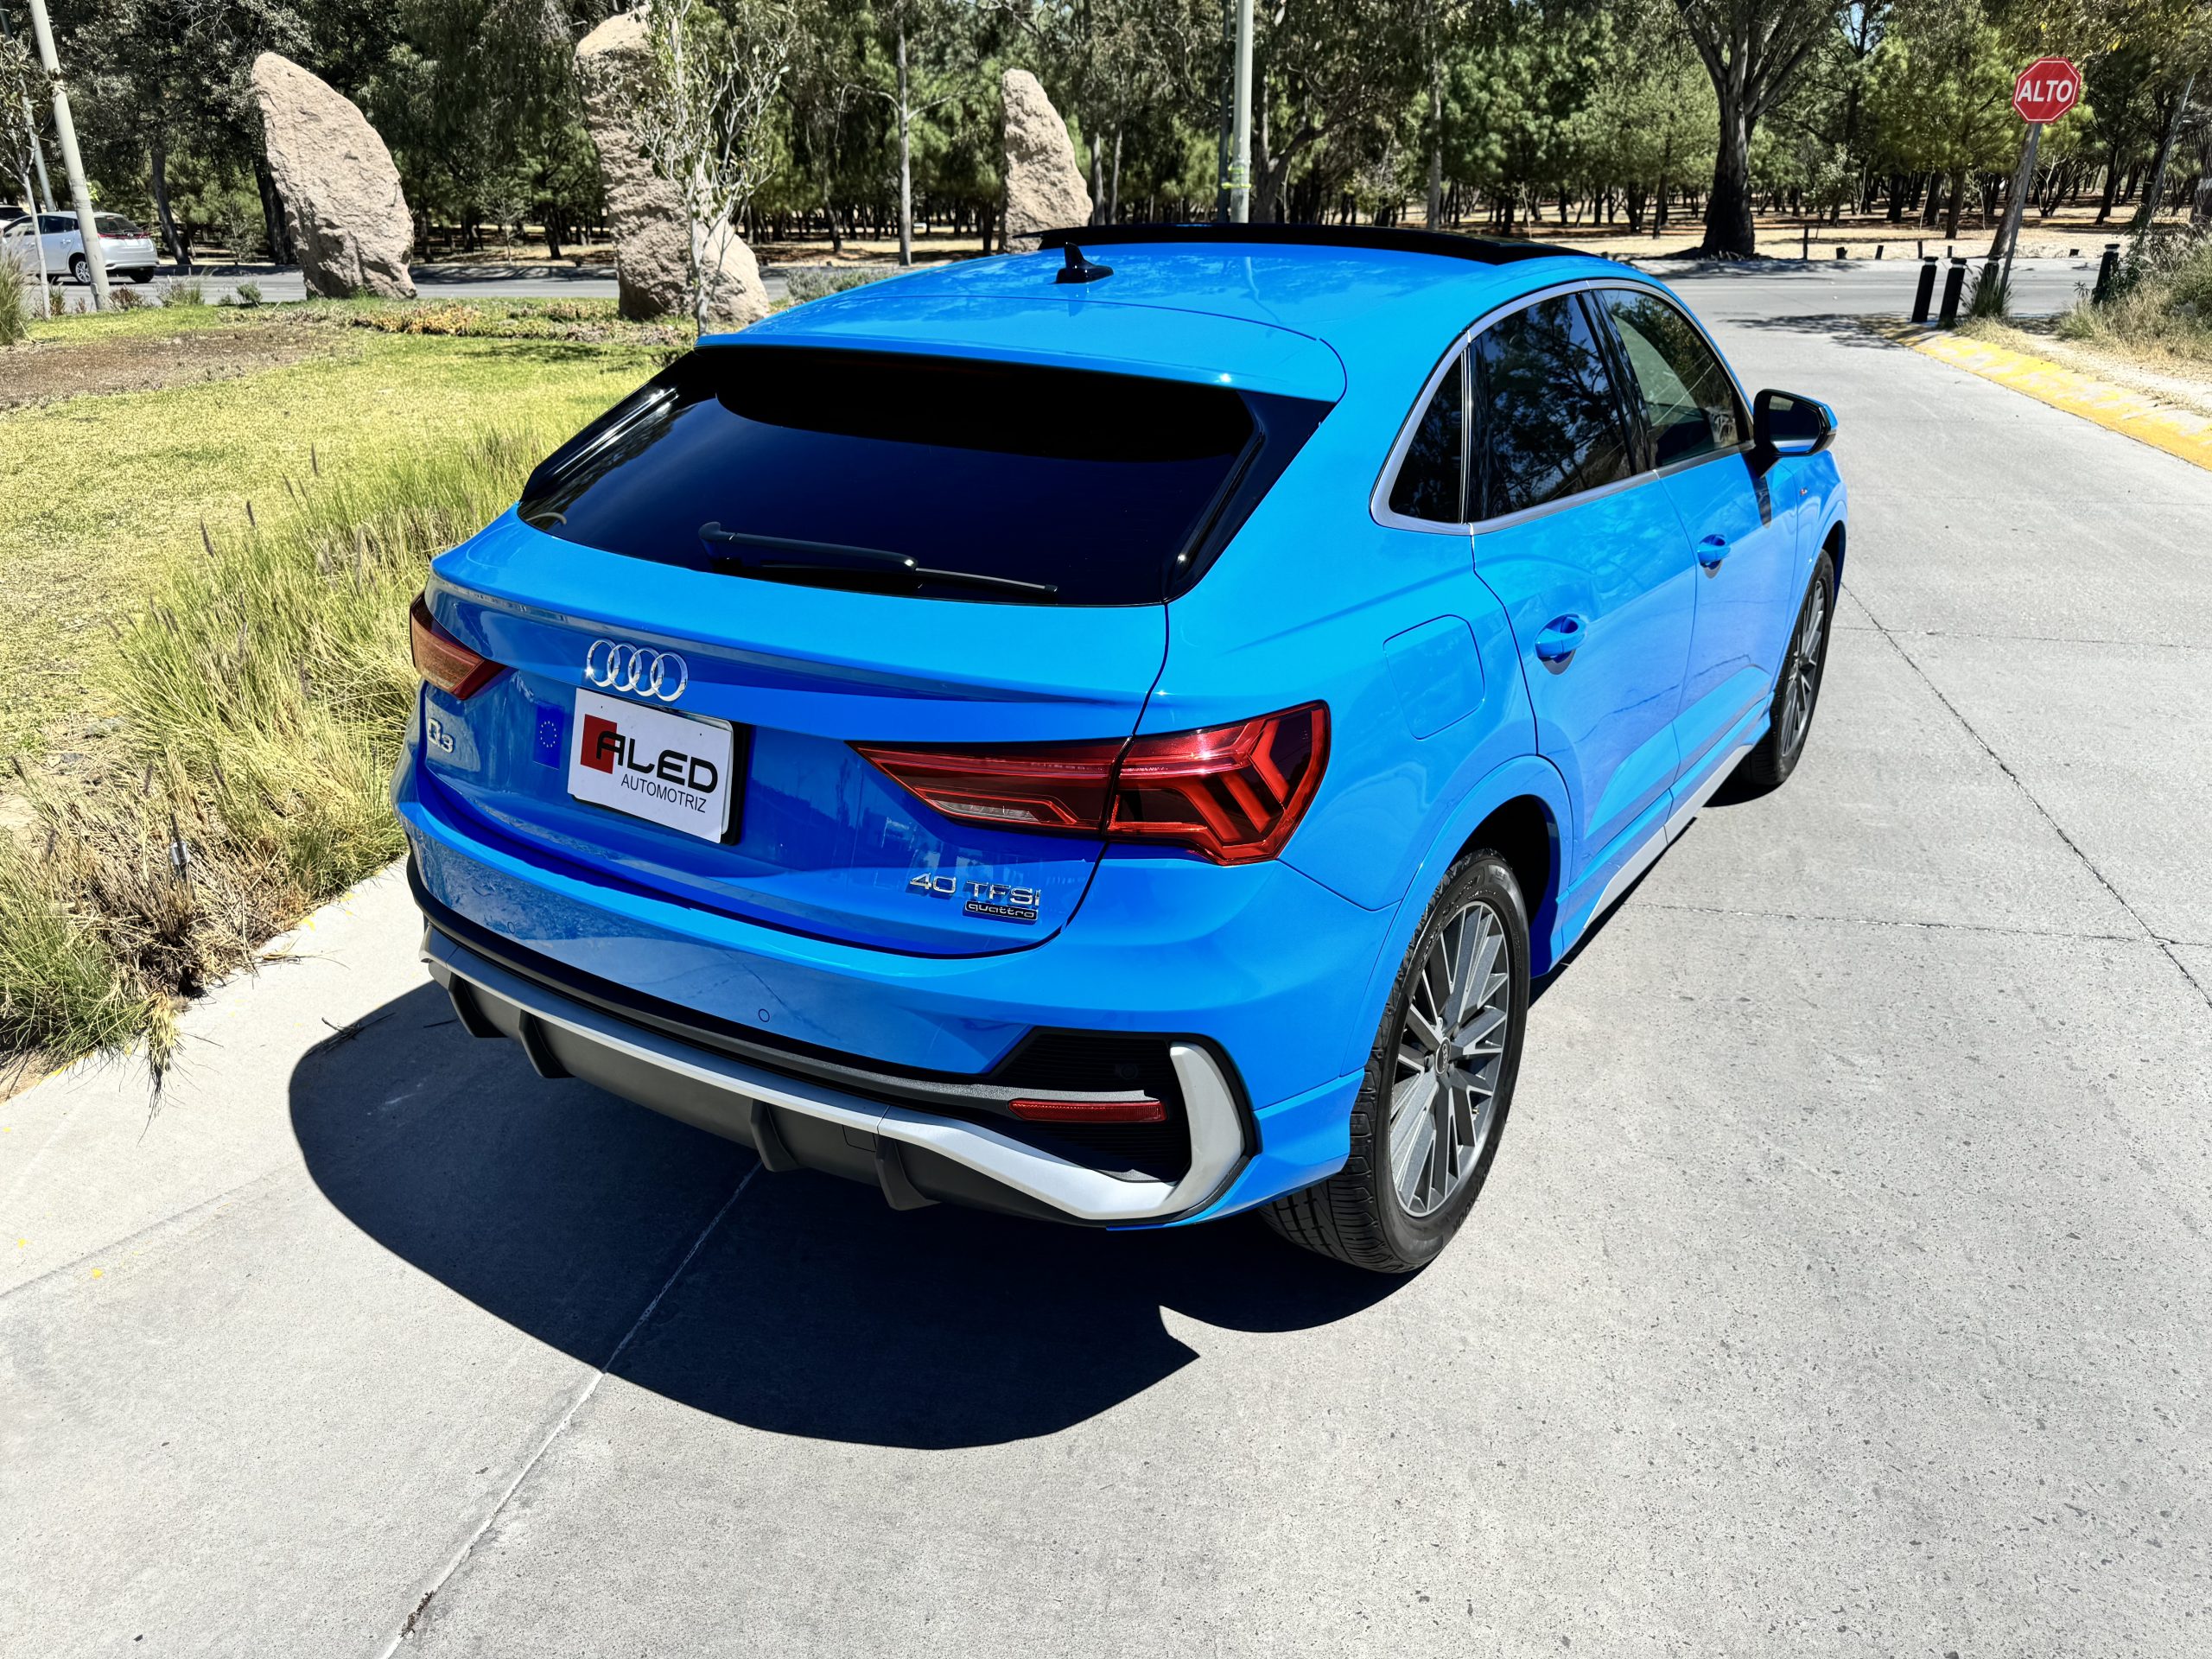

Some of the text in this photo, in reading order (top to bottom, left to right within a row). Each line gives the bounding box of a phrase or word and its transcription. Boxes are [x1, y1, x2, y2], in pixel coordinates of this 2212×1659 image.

[2017, 79, 2073, 103] ALTO
[429, 718, 454, 753] Q3
[596, 730, 719, 794] ALED
[620, 773, 707, 814] AUTOMOTRIZ
[910, 872, 1041, 906] 40 TFSI
[969, 902, 1034, 918] quattro
